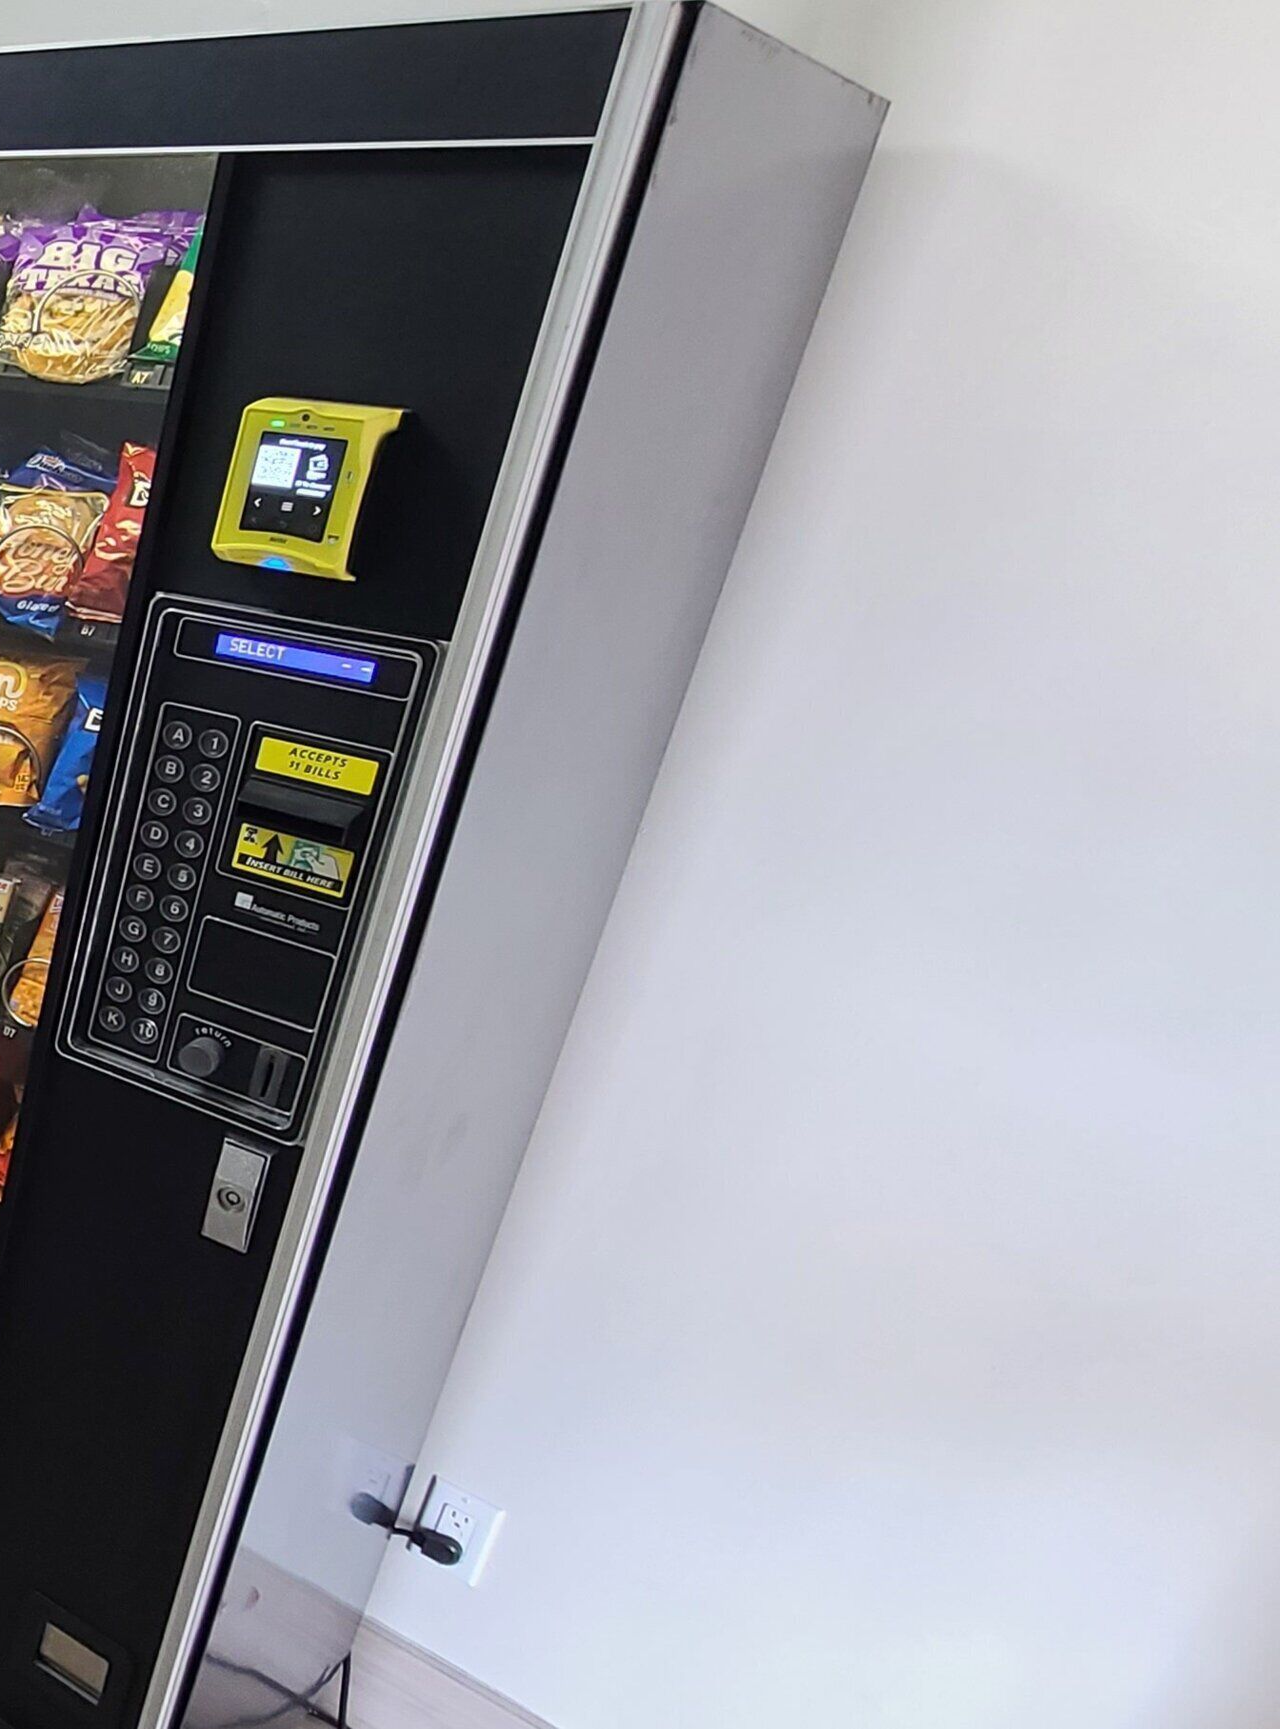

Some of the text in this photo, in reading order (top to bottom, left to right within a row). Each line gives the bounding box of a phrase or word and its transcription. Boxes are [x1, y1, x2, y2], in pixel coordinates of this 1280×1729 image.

[42, 240, 138, 273] BIG
[2, 559, 69, 594] Bun
[229, 638, 286, 660] SELECT
[172, 728, 185, 742] A
[211, 737, 219, 750] 1
[289, 746, 348, 768] ACCEPTS
[165, 761, 177, 775] B
[305, 763, 341, 781] BILLS
[201, 770, 212, 784] 2
[157, 794, 170, 808] C
[193, 804, 203, 817] 3
[149, 827, 162, 840] D
[185, 837, 195, 850] 4
[142, 858, 154, 873] E
[245, 856, 335, 889] INSERT BILL HERE
[177, 869, 188, 883] 5
[136, 891, 147, 902] F
[170, 902, 180, 914] 6
[127, 921, 139, 935] G
[163, 933, 173, 945] 7
[121, 952, 132, 966] H
[155, 963, 165, 976] 8
[115, 983, 125, 995] J
[148, 992, 157, 1006] 9
[107, 1011, 118, 1025] K
[139, 1023, 154, 1038] 10
[194, 1026, 233, 1048] return
